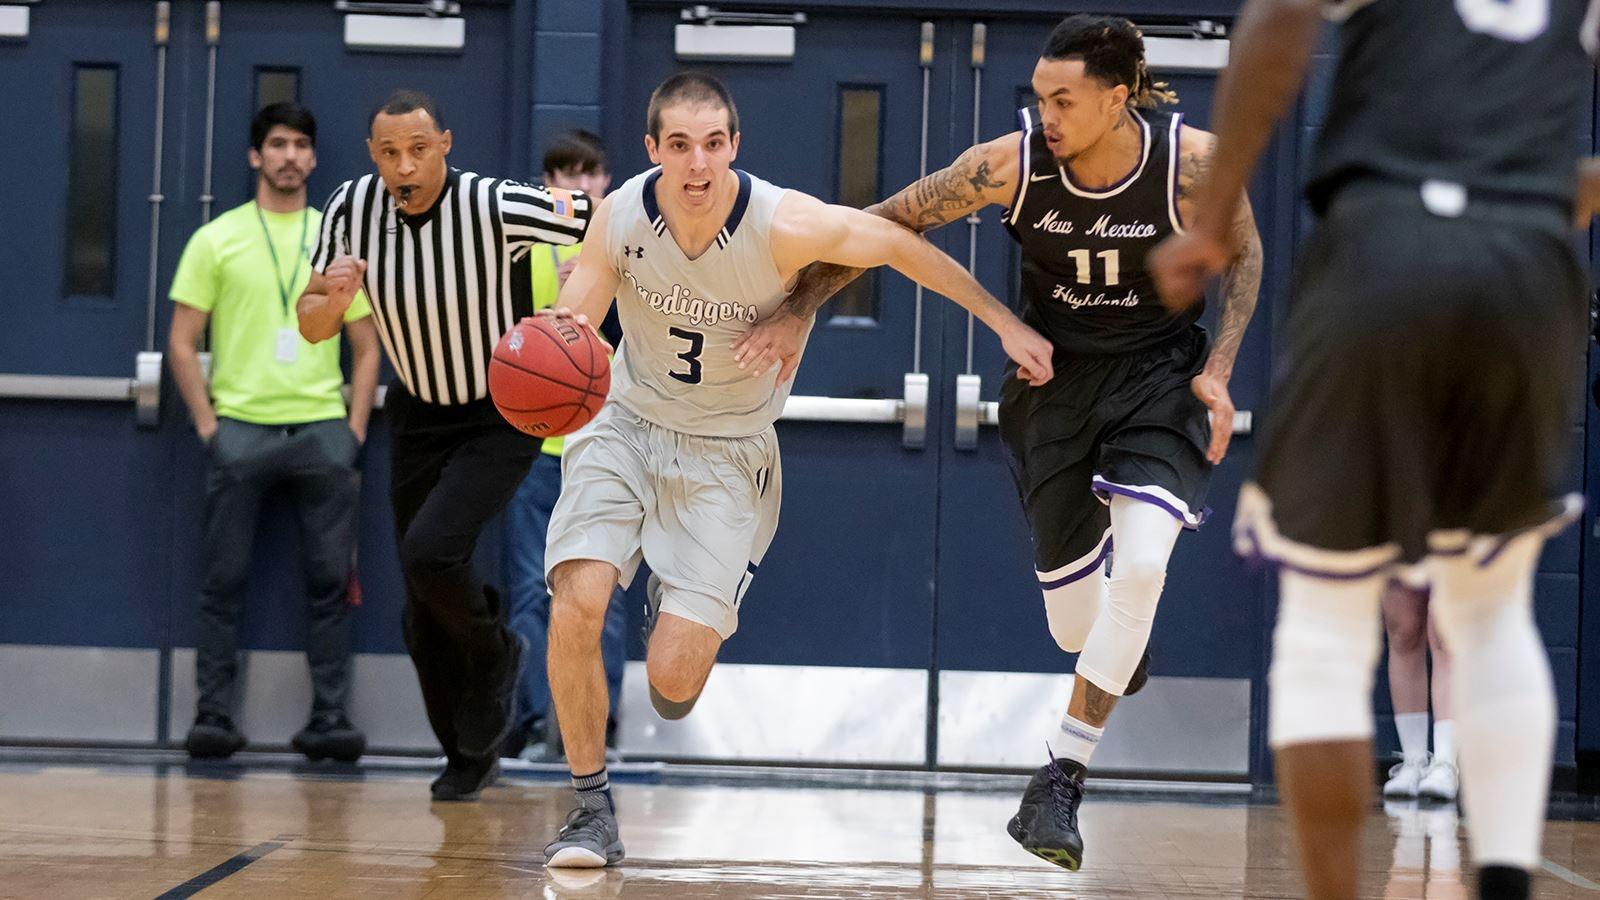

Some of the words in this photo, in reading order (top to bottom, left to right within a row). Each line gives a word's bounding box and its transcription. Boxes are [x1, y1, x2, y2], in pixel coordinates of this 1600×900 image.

[1033, 209, 1074, 234] New
[1085, 214, 1157, 238] Mexico
[1067, 248, 1120, 286] 11
[667, 325, 704, 386] 3
